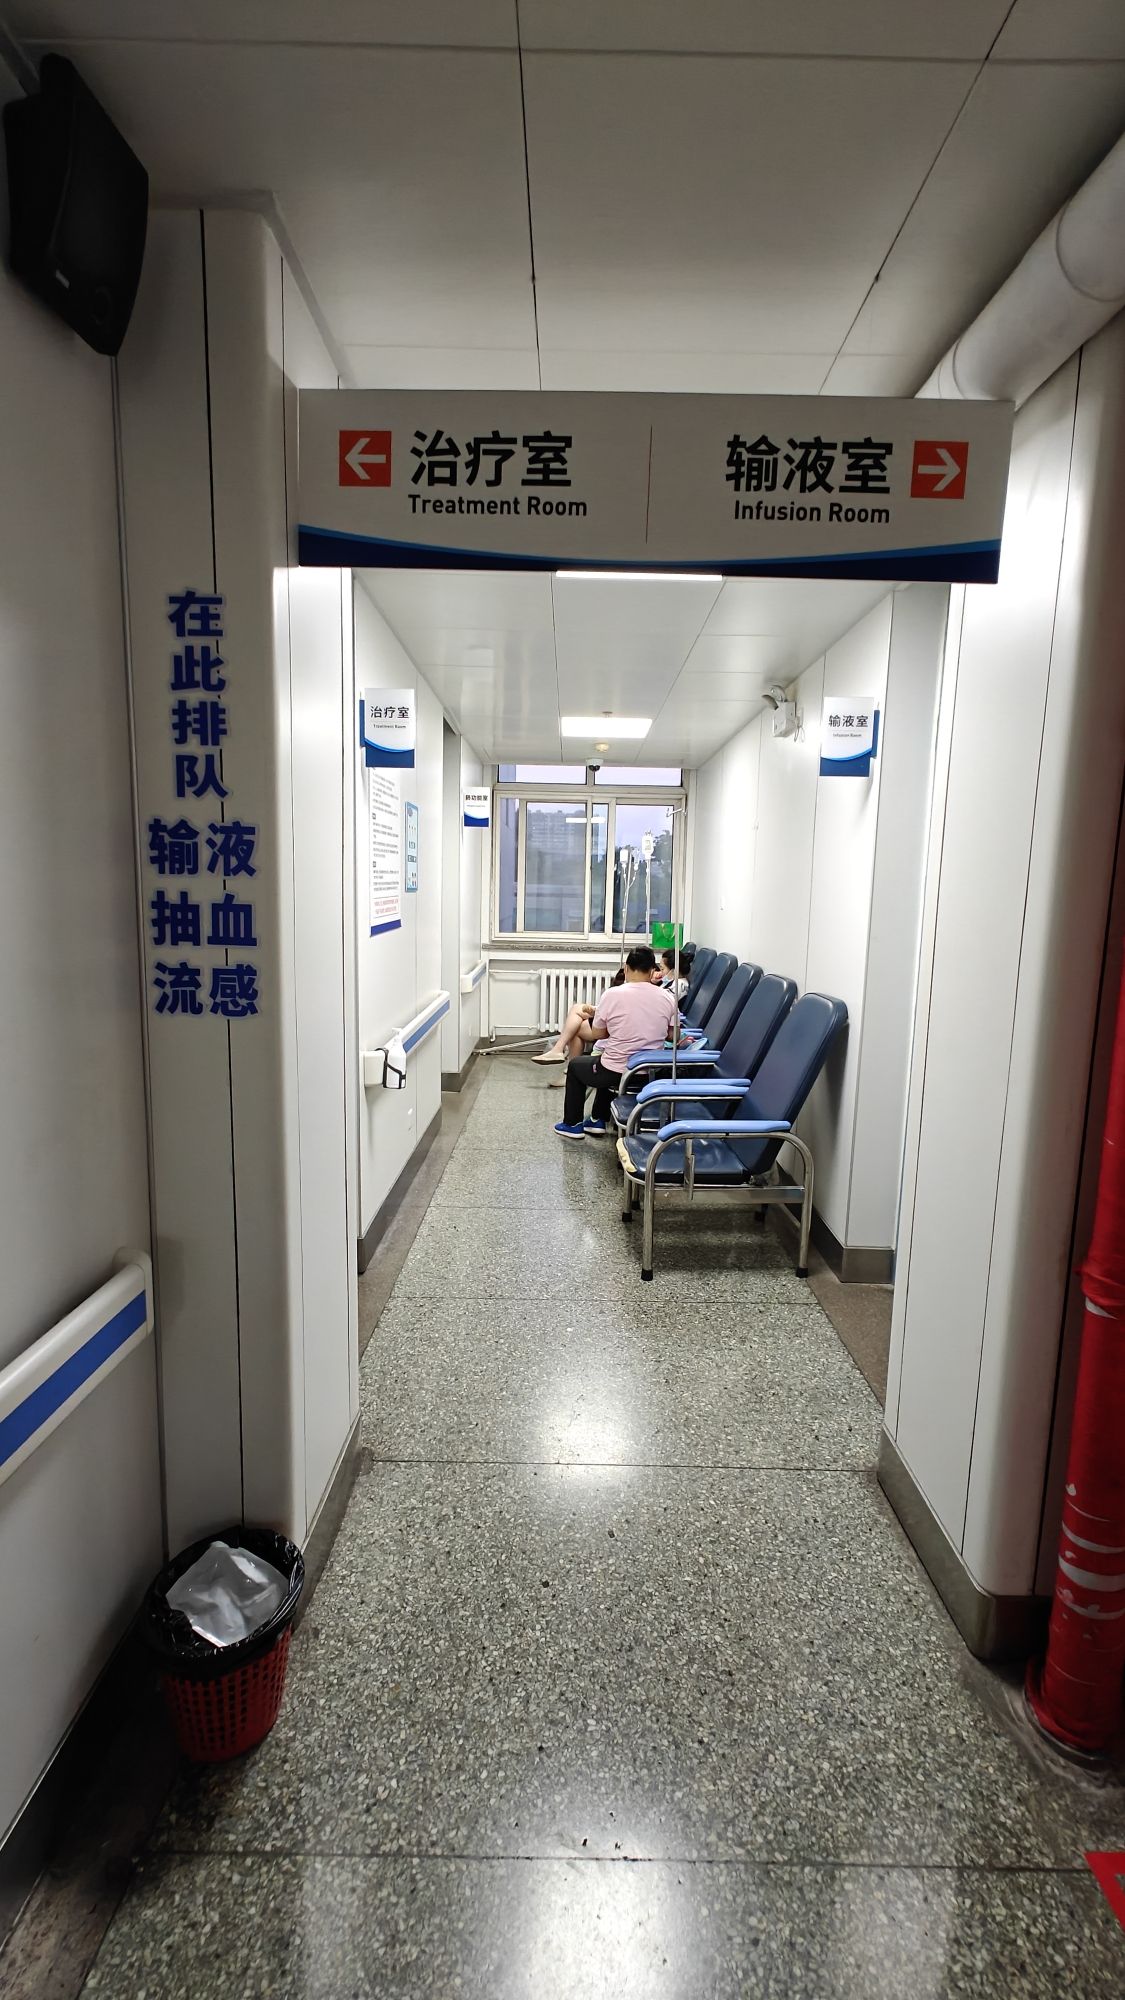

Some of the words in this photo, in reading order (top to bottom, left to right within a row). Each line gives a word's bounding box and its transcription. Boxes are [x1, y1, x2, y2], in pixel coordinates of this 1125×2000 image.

[409, 429, 573, 489] 治疗室
[724, 434, 894, 495] 输液室
[408, 494, 521, 517] Treatment
[526, 495, 588, 518] Room
[733, 499, 822, 523] Infusion
[827, 502, 891, 524] Room
[168, 590, 228, 799] 在此排队
[370, 705, 410, 719] 治疗室
[828, 714, 869, 728] 输液室
[148, 818, 258, 877] 输液
[151, 891, 258, 948] 抽血
[153, 961, 259, 1018] 流感
